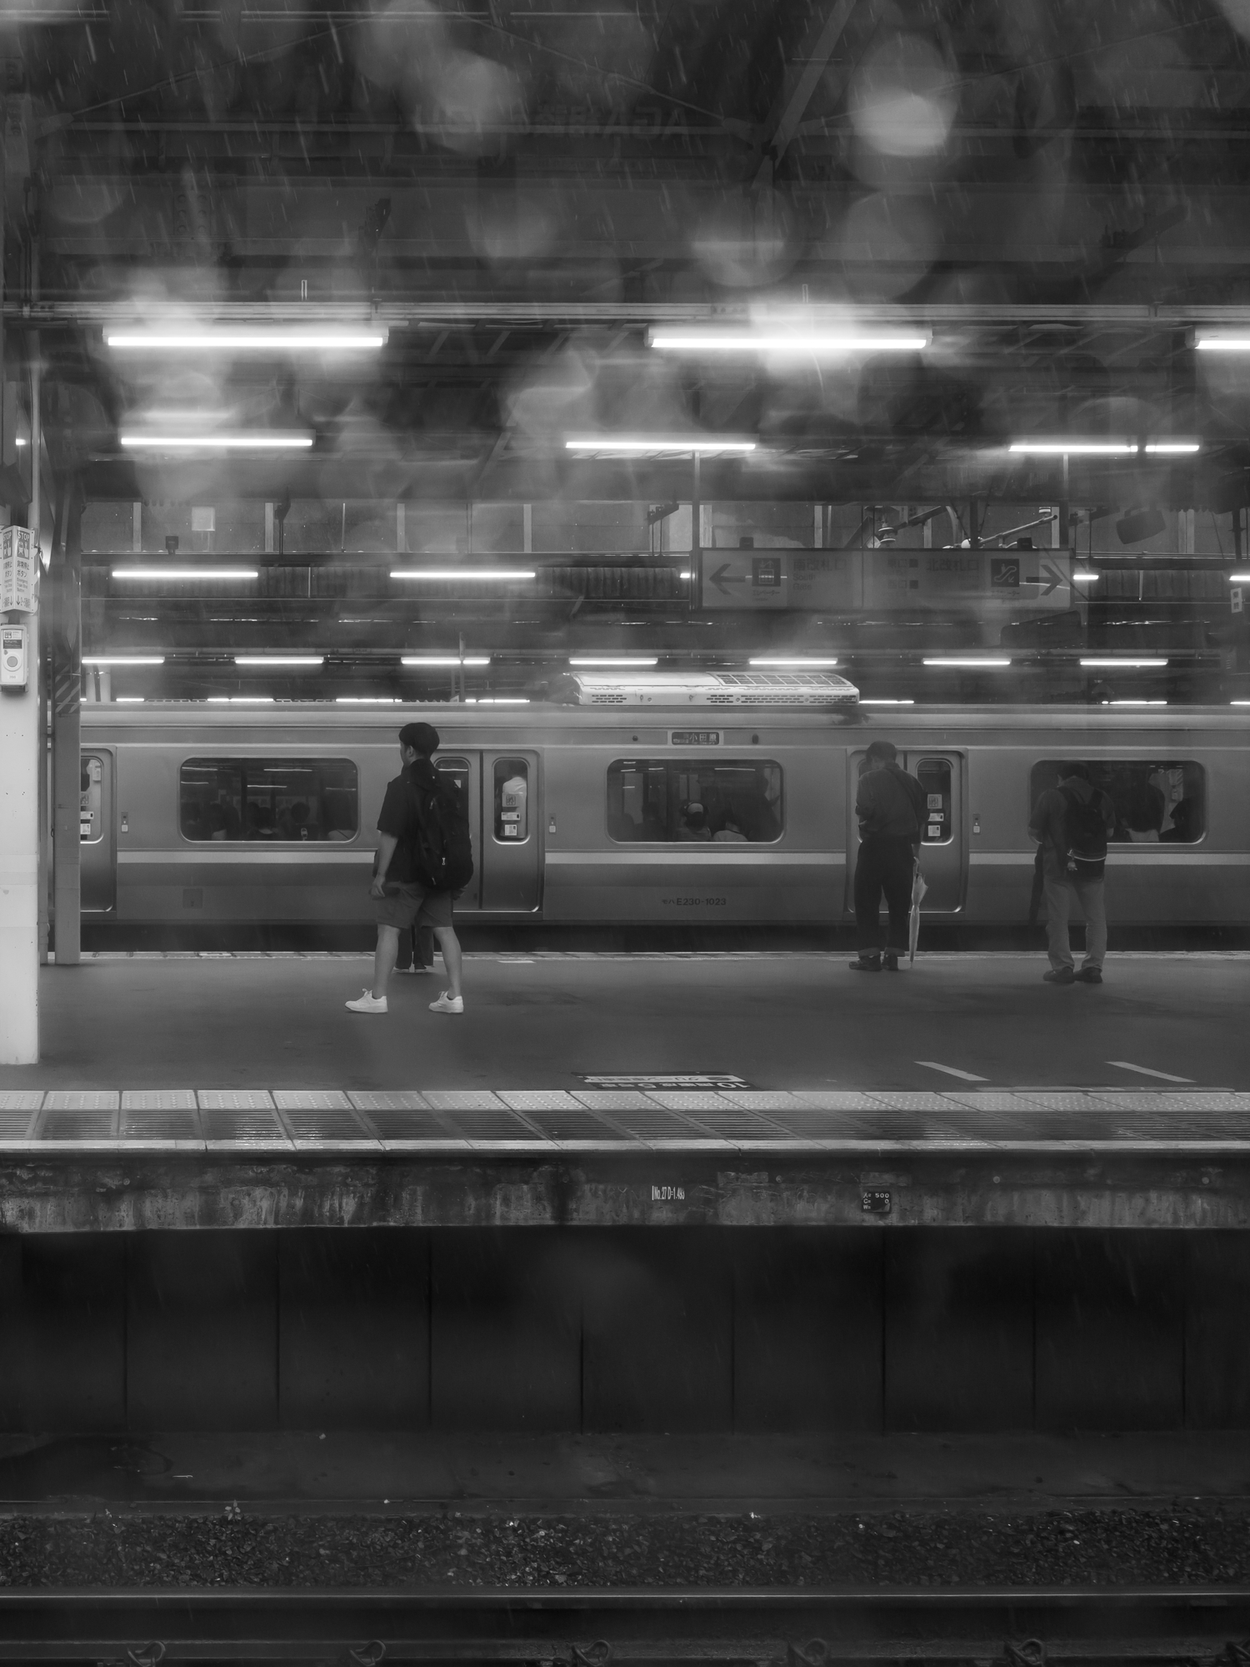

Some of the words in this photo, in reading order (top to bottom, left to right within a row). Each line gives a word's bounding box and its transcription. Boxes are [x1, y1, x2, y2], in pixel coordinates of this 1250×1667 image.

[17, 530, 30, 541] STOP
[793, 557, 847, 571] 南改札口
[926, 558, 979, 571] 北改札口
[17, 569, 28, 578] ボタン
[792, 572, 816, 581] South
[792, 582, 813, 591] Gate
